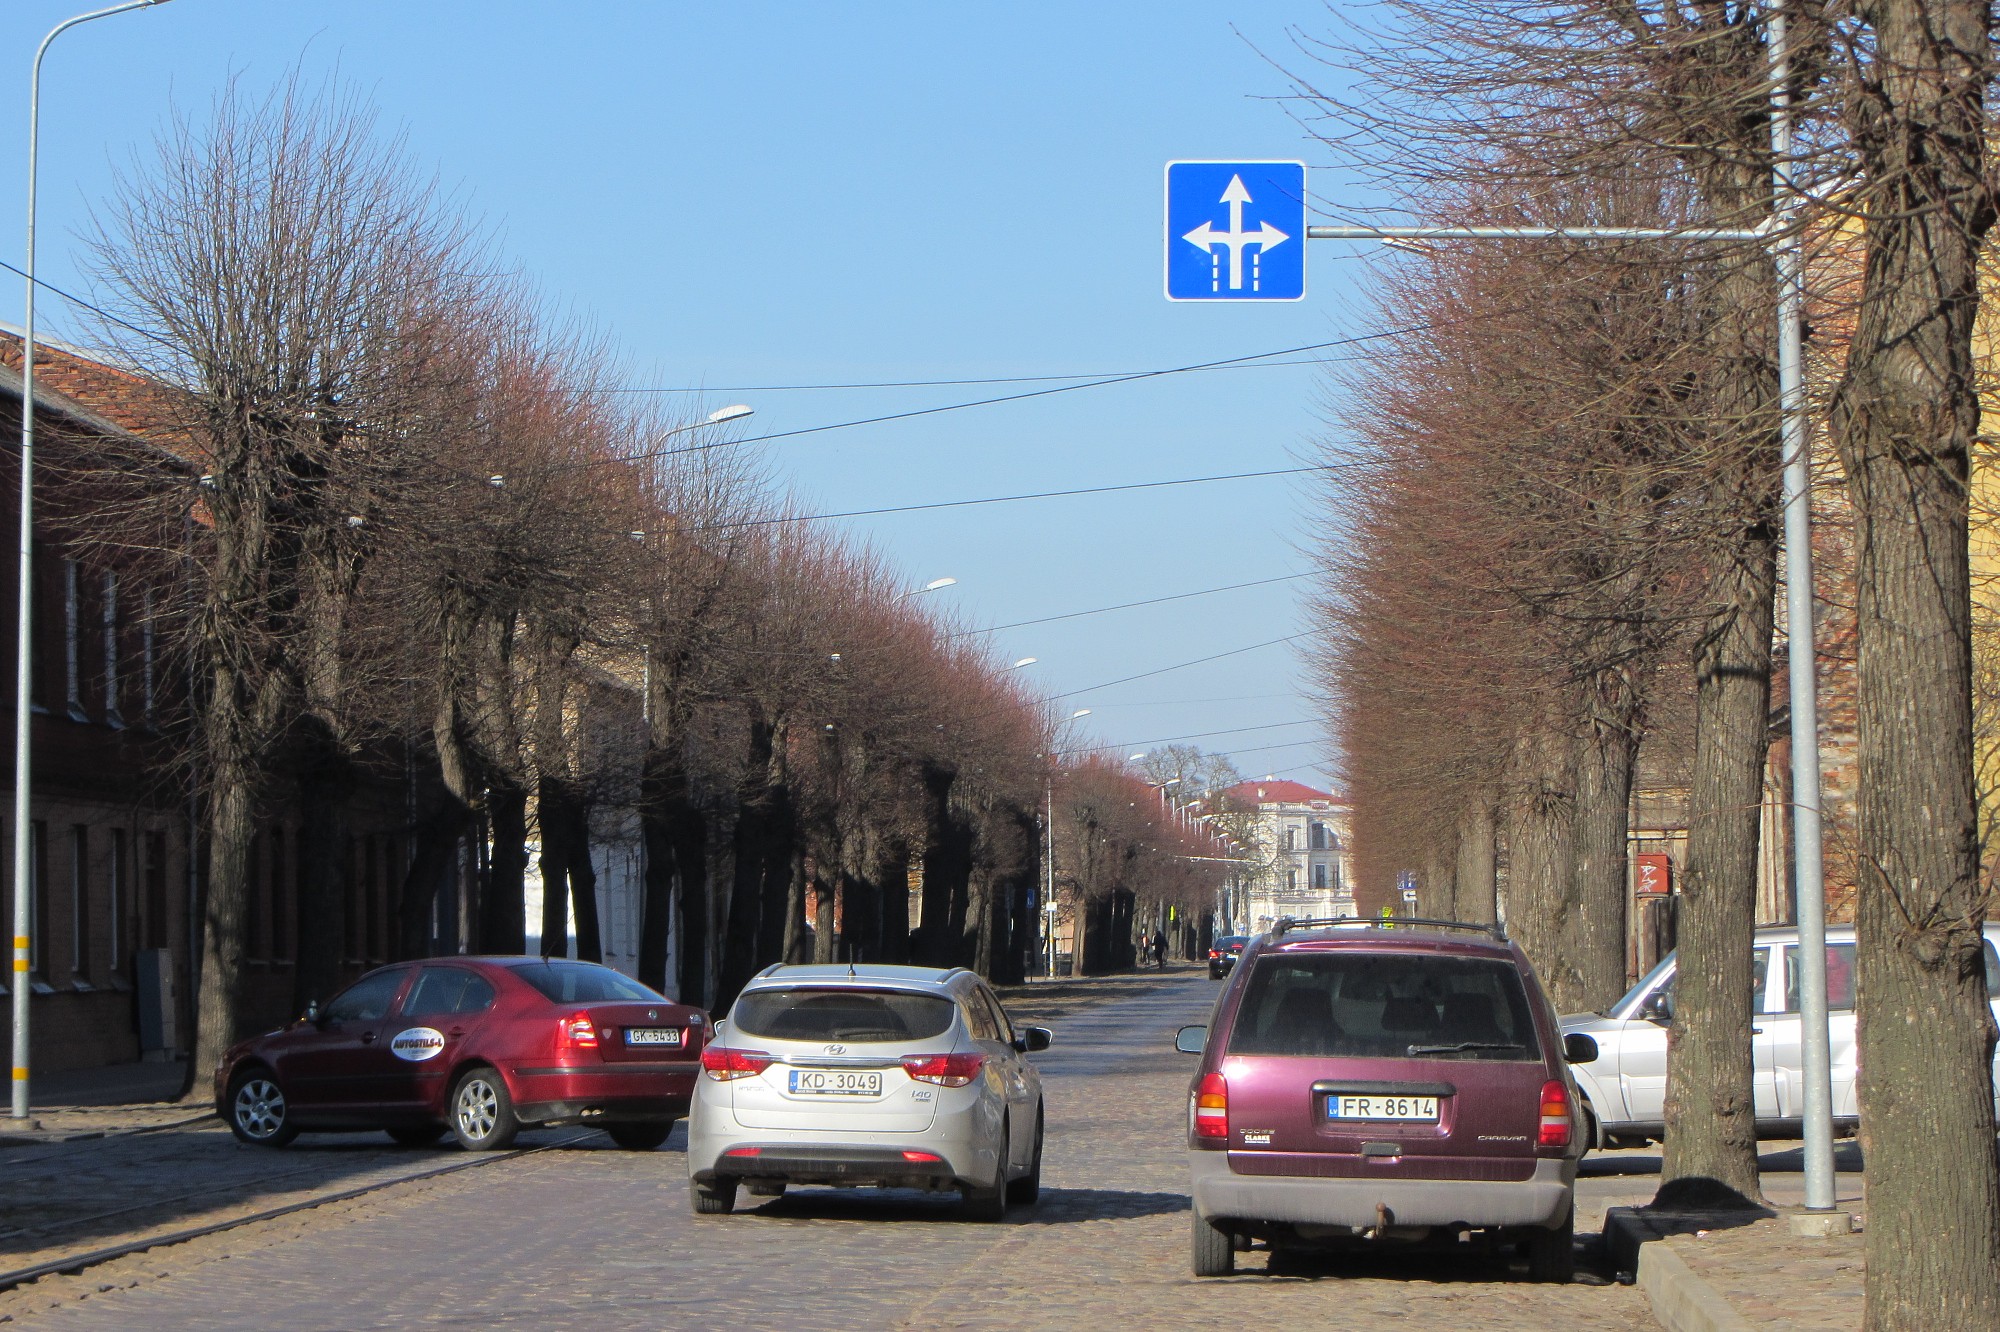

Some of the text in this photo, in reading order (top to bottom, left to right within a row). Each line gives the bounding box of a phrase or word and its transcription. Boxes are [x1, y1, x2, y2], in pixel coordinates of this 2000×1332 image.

[633, 1030, 678, 1042] GK-5433
[801, 1073, 877, 1089] KD-3049
[1343, 1098, 1434, 1116] FR-8614
